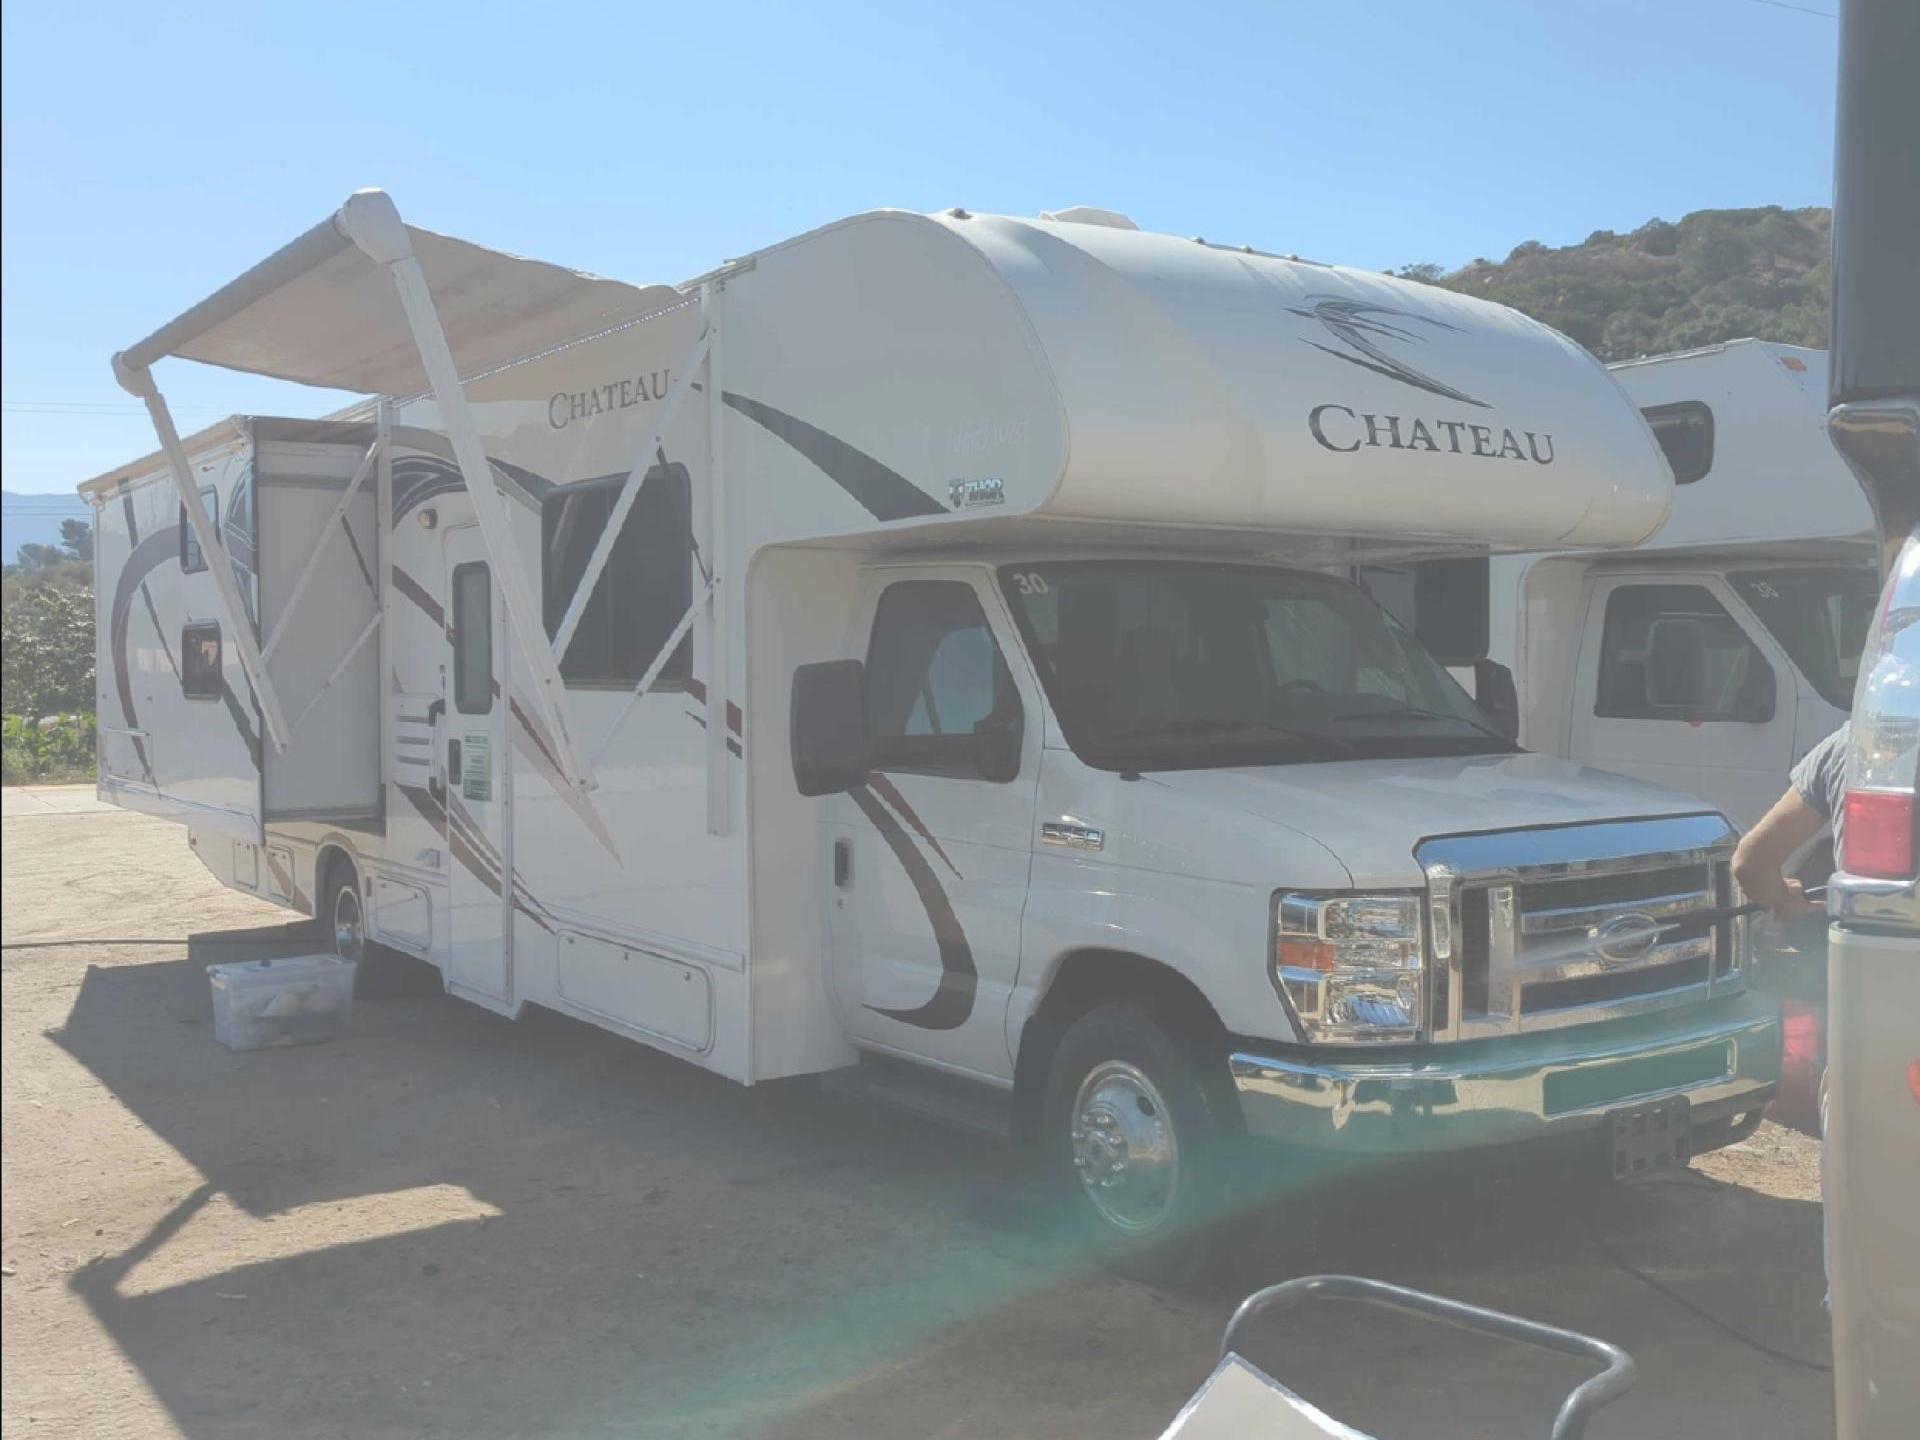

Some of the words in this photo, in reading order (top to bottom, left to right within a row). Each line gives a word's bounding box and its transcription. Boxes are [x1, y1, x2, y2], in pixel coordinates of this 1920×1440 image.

[548, 369, 671, 430] CHATEAU
[1308, 403, 1555, 465] CHATEAU
[1013, 572, 1049, 594] 30
